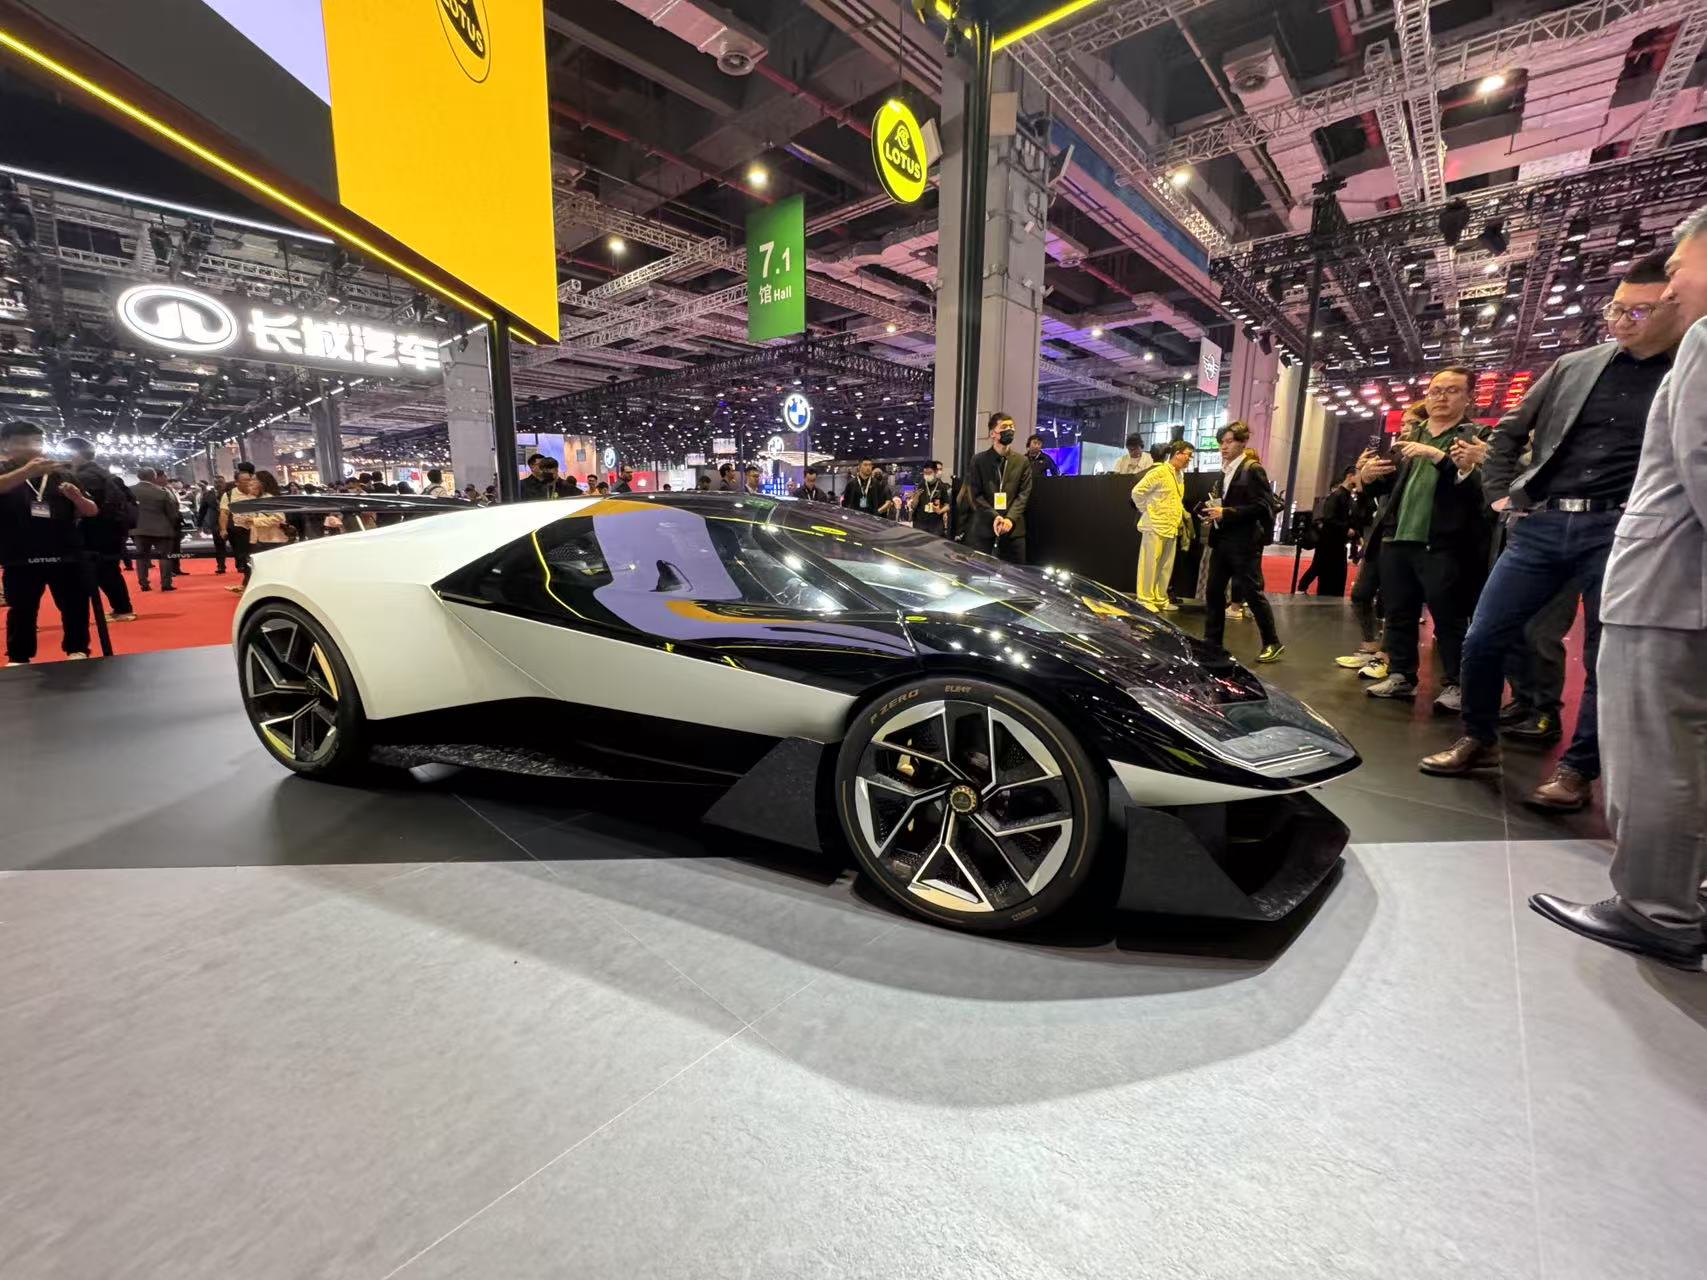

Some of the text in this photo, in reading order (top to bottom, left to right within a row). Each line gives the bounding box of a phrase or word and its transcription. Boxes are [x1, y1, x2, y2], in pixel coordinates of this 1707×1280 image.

[885, 142, 921, 179] LOTUS
[759, 240, 791, 279] 7.1
[759, 284, 792, 305] 馆 Hall
[880, 689, 919, 715] ZERO
